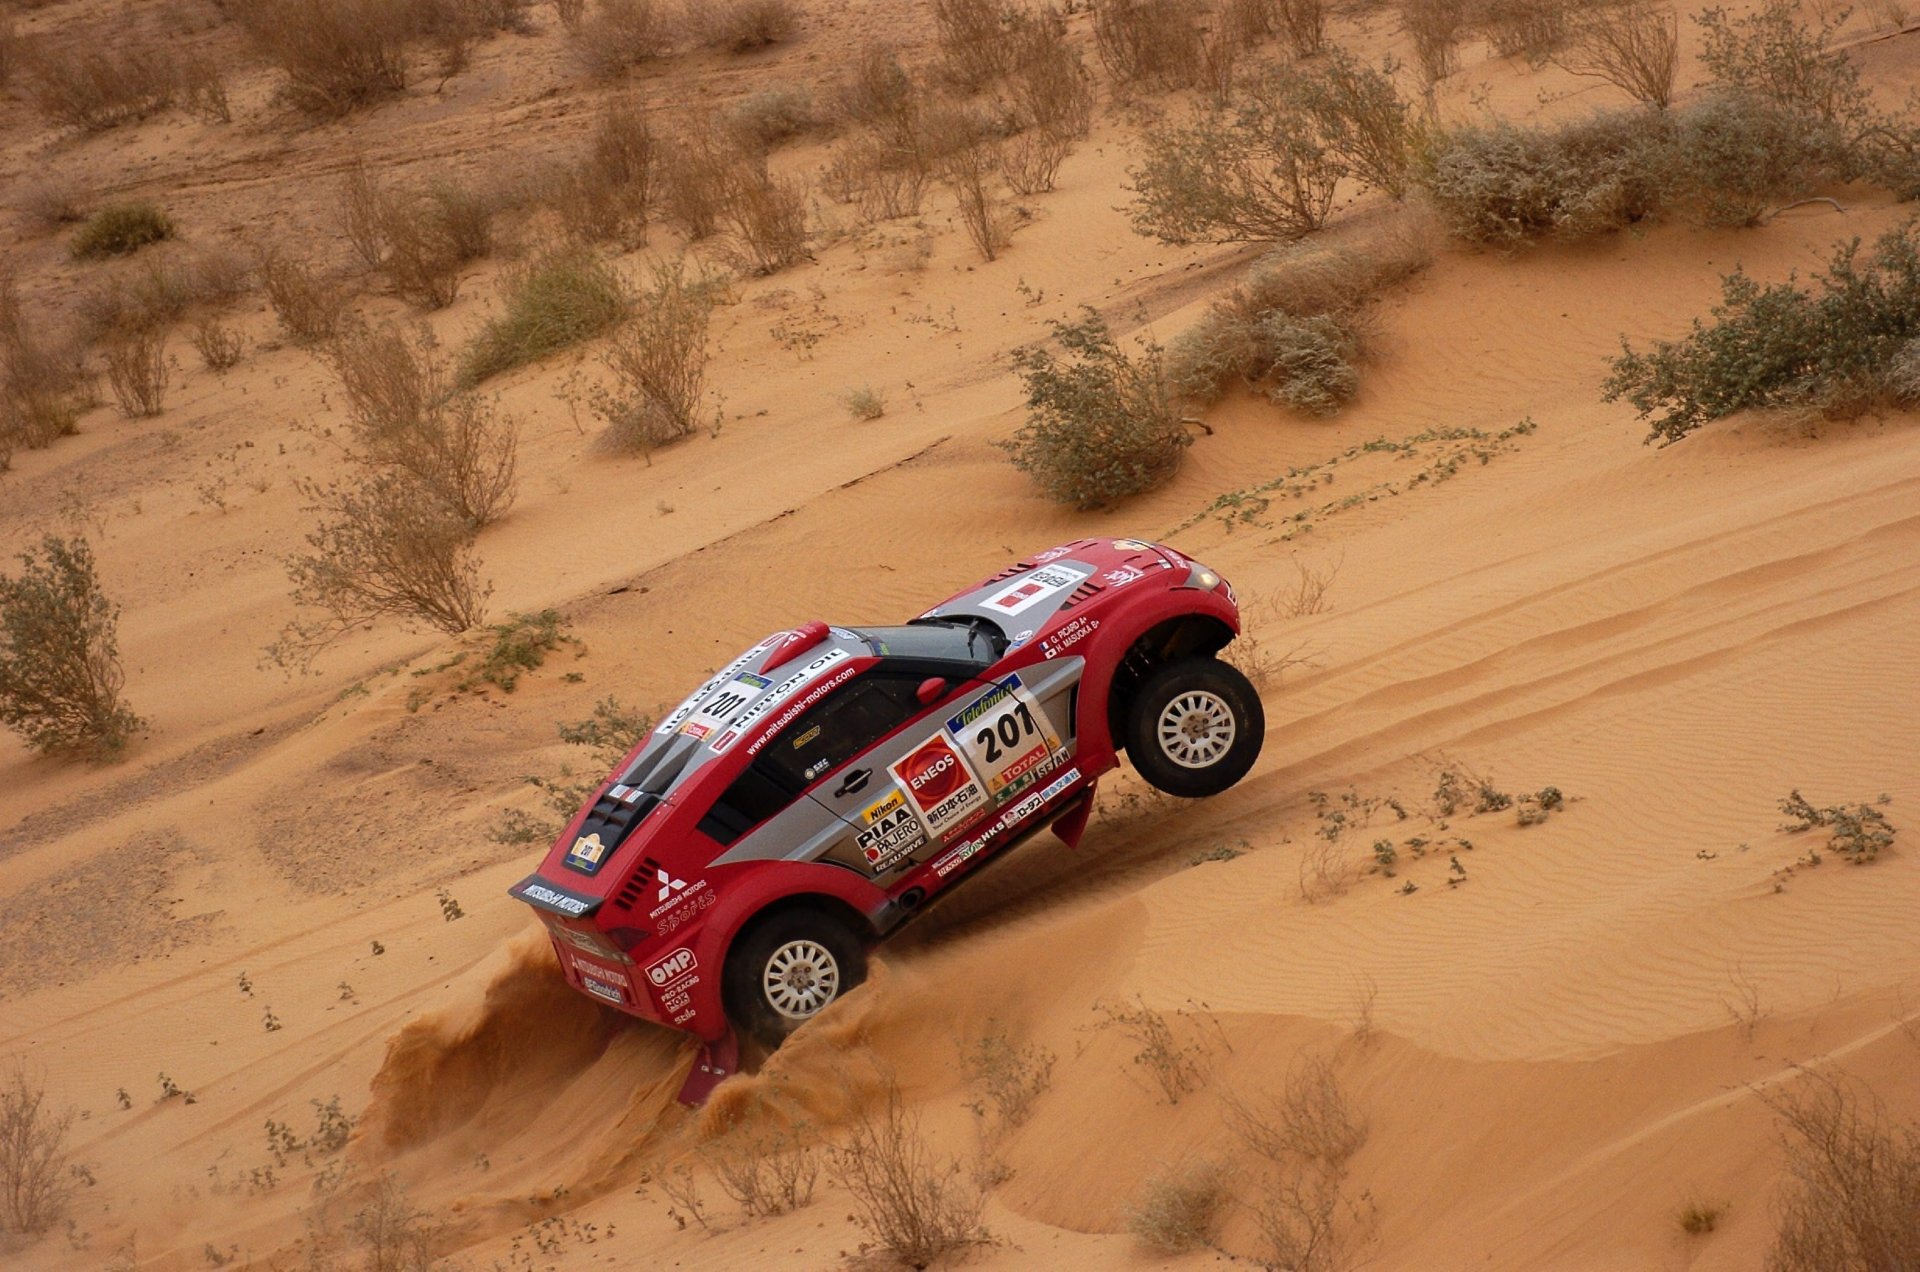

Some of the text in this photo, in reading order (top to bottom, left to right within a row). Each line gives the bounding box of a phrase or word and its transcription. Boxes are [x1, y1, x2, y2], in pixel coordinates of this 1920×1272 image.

[1057, 621, 1080, 639] PICARD
[1063, 625, 1093, 648] MASUOKA
[702, 692, 747, 719] 201
[735, 672, 805, 728] NIPPON
[809, 651, 843, 670] OIL
[746, 666, 856, 755] www.mitsubishi-motors.com
[977, 702, 1034, 763] 201
[910, 754, 955, 790] ENEOS
[1003, 750, 1046, 780] TOTAL
[870, 798, 899, 821] Nikon
[926, 783, 978, 824] 新日本石油
[857, 808, 911, 848] PIAA
[877, 820, 919, 855] PAJERO
[981, 821, 1005, 842] HKS
[649, 880, 707, 919] MITSUBISHI MOTORS
[651, 950, 691, 984] OMP
